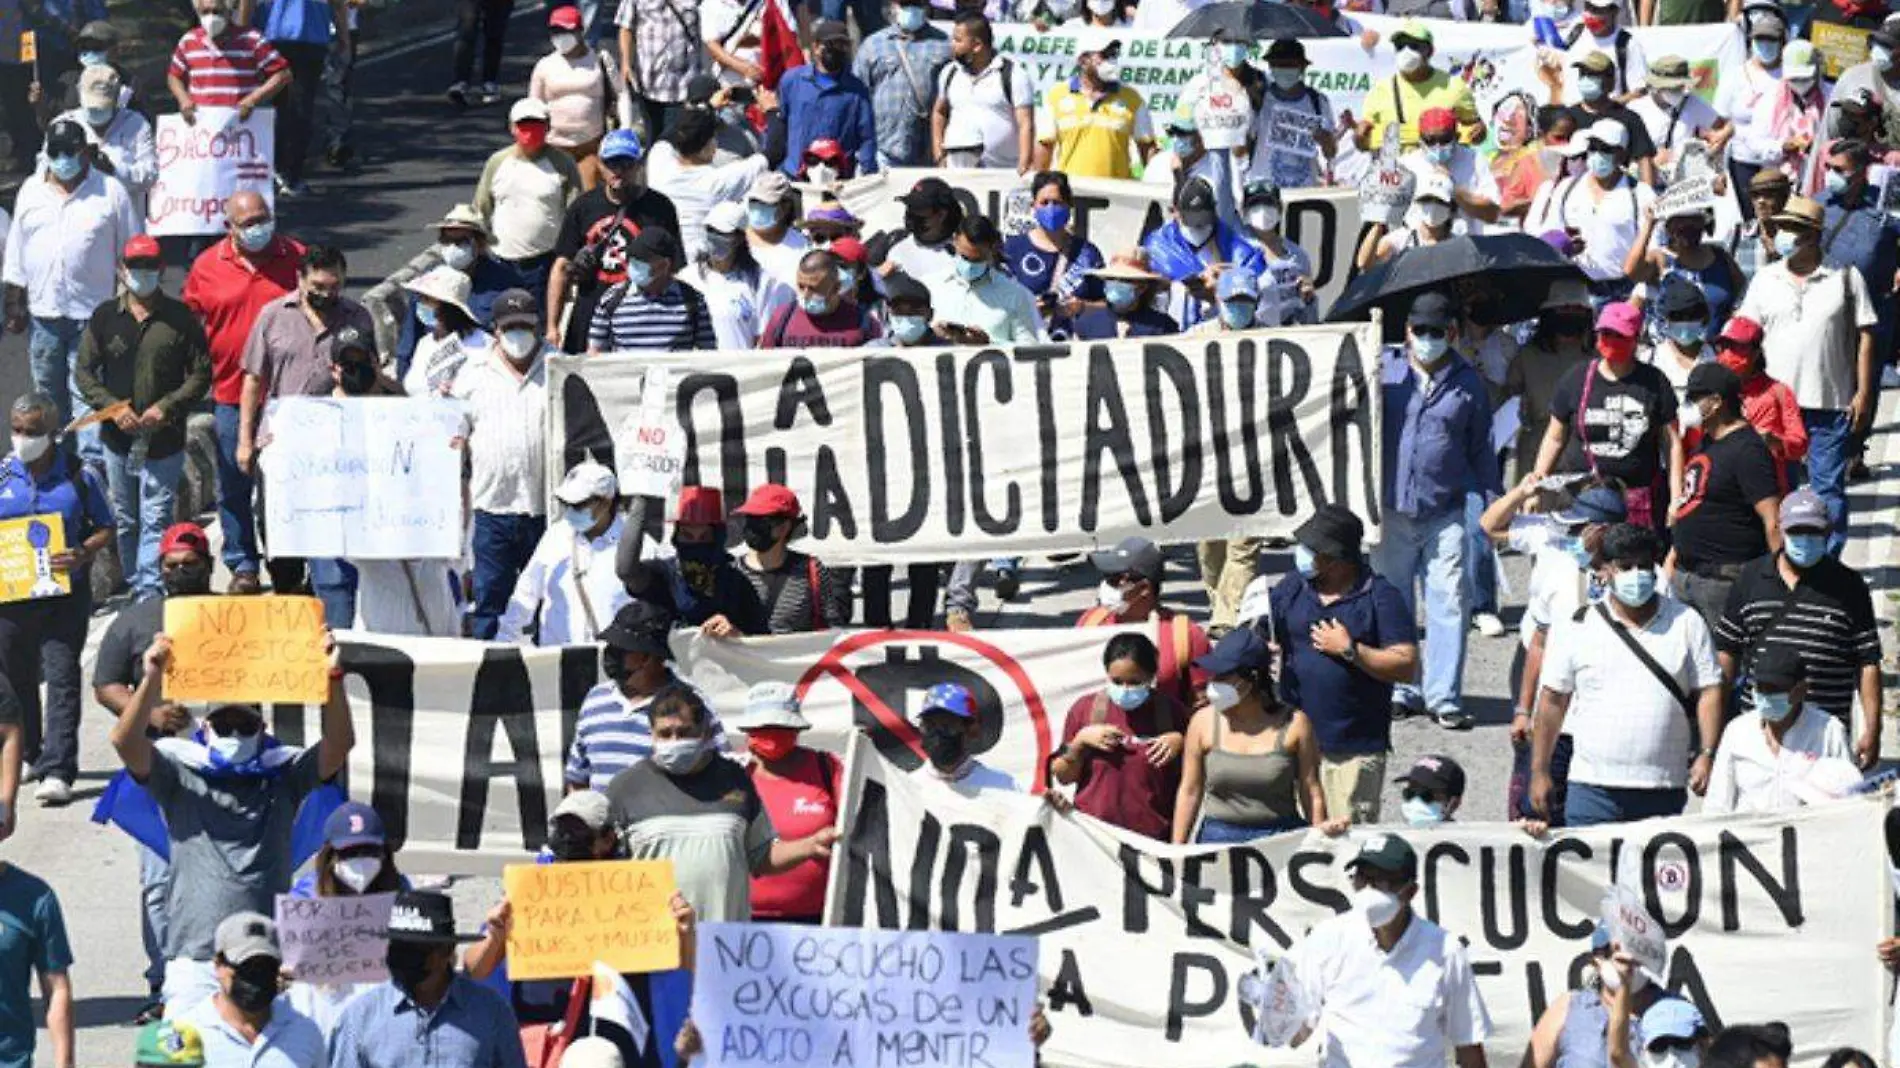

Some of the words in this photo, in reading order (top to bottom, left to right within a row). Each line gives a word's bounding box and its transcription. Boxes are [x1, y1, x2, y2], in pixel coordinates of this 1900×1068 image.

[1128, 40, 1158, 57] DE
[1163, 41, 1193, 58] LA
[638, 426, 666, 446] NO
[773, 356, 834, 430] A
[863, 333, 1381, 543] DICTADURA
[198, 601, 247, 637] NO
[197, 638, 323, 664] GASTOS
[842, 779, 1000, 933] NO
[1010, 825, 1064, 912] A
[1119, 826, 1805, 951] PERSCUCON
[527, 870, 655, 903] JUSTICIA
[340, 903, 374, 920] LA
[524, 904, 586, 929] PARA
[595, 901, 650, 924] LAS
[1619, 903, 1647, 935] NO
[714, 931, 775, 973] NO
[960, 947, 1034, 983] LAS
[976, 996, 1020, 1030] UN
[832, 1029, 854, 1067] A
